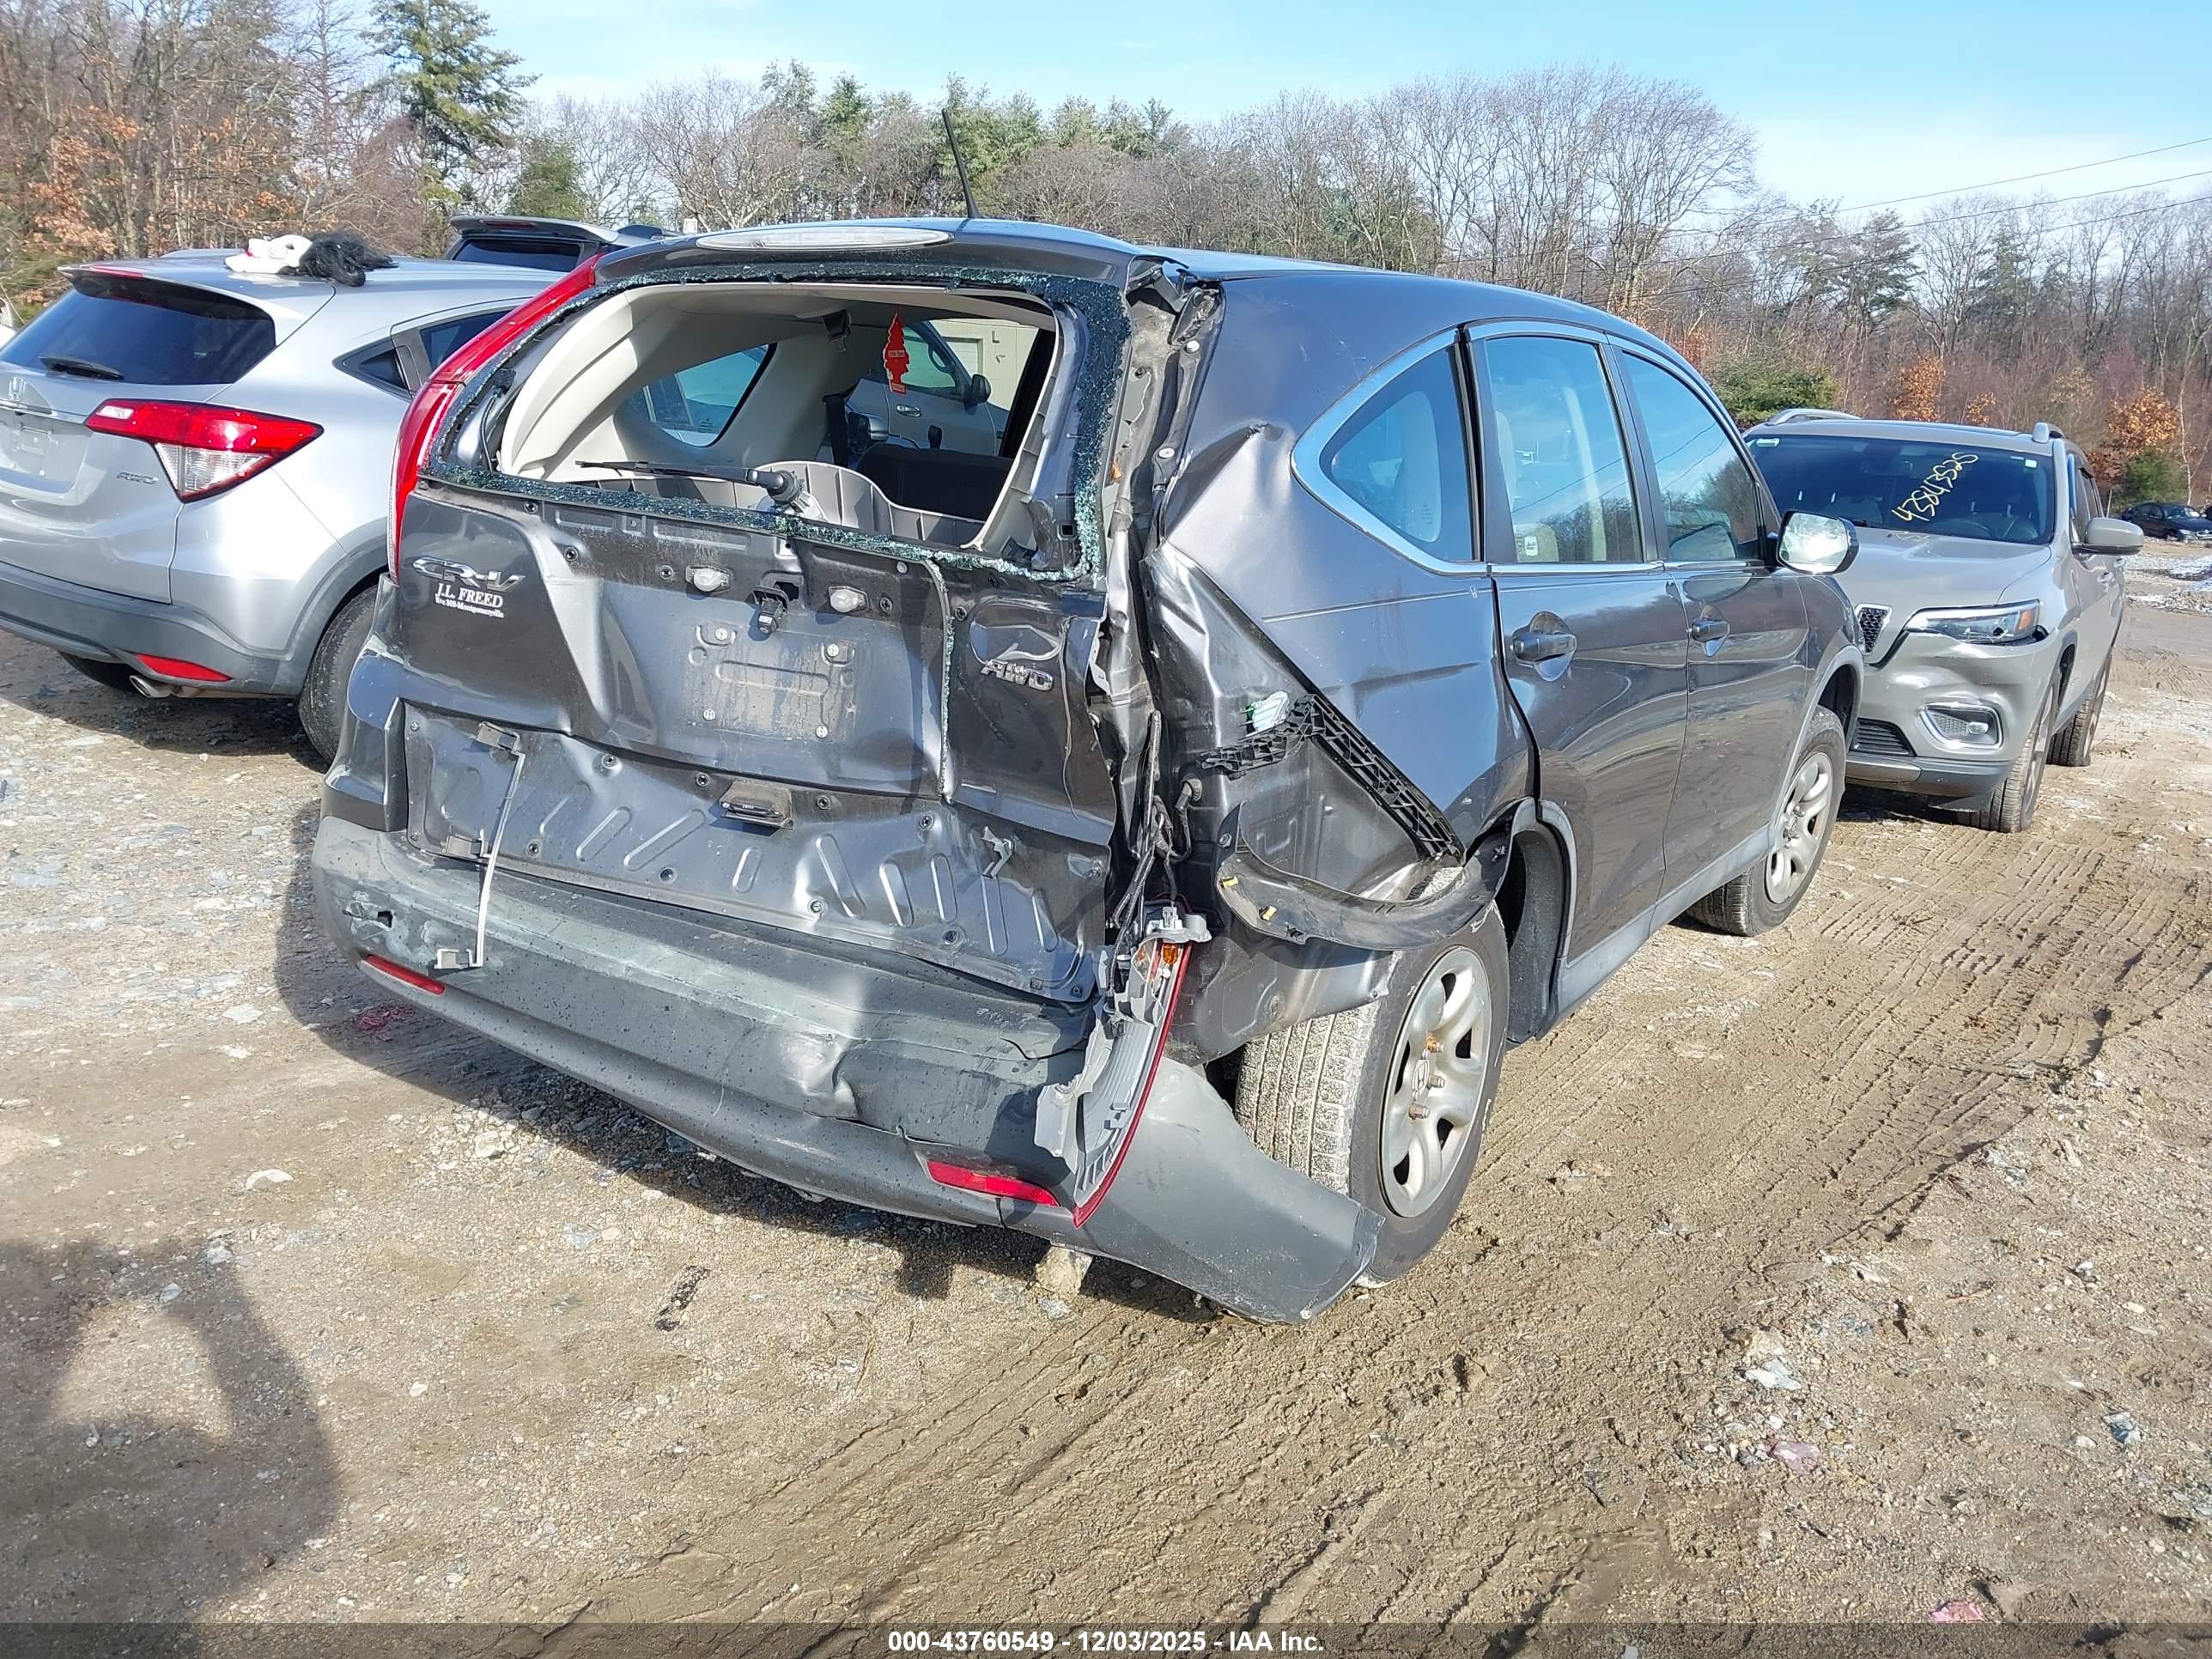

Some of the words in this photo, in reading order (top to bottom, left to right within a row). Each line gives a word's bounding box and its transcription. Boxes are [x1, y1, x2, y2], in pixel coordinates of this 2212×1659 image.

[412, 556, 526, 592] CR-V
[434, 583, 455, 599] J.L.
[458, 587, 503, 608] FREED
[981, 659, 1054, 691] AWD
